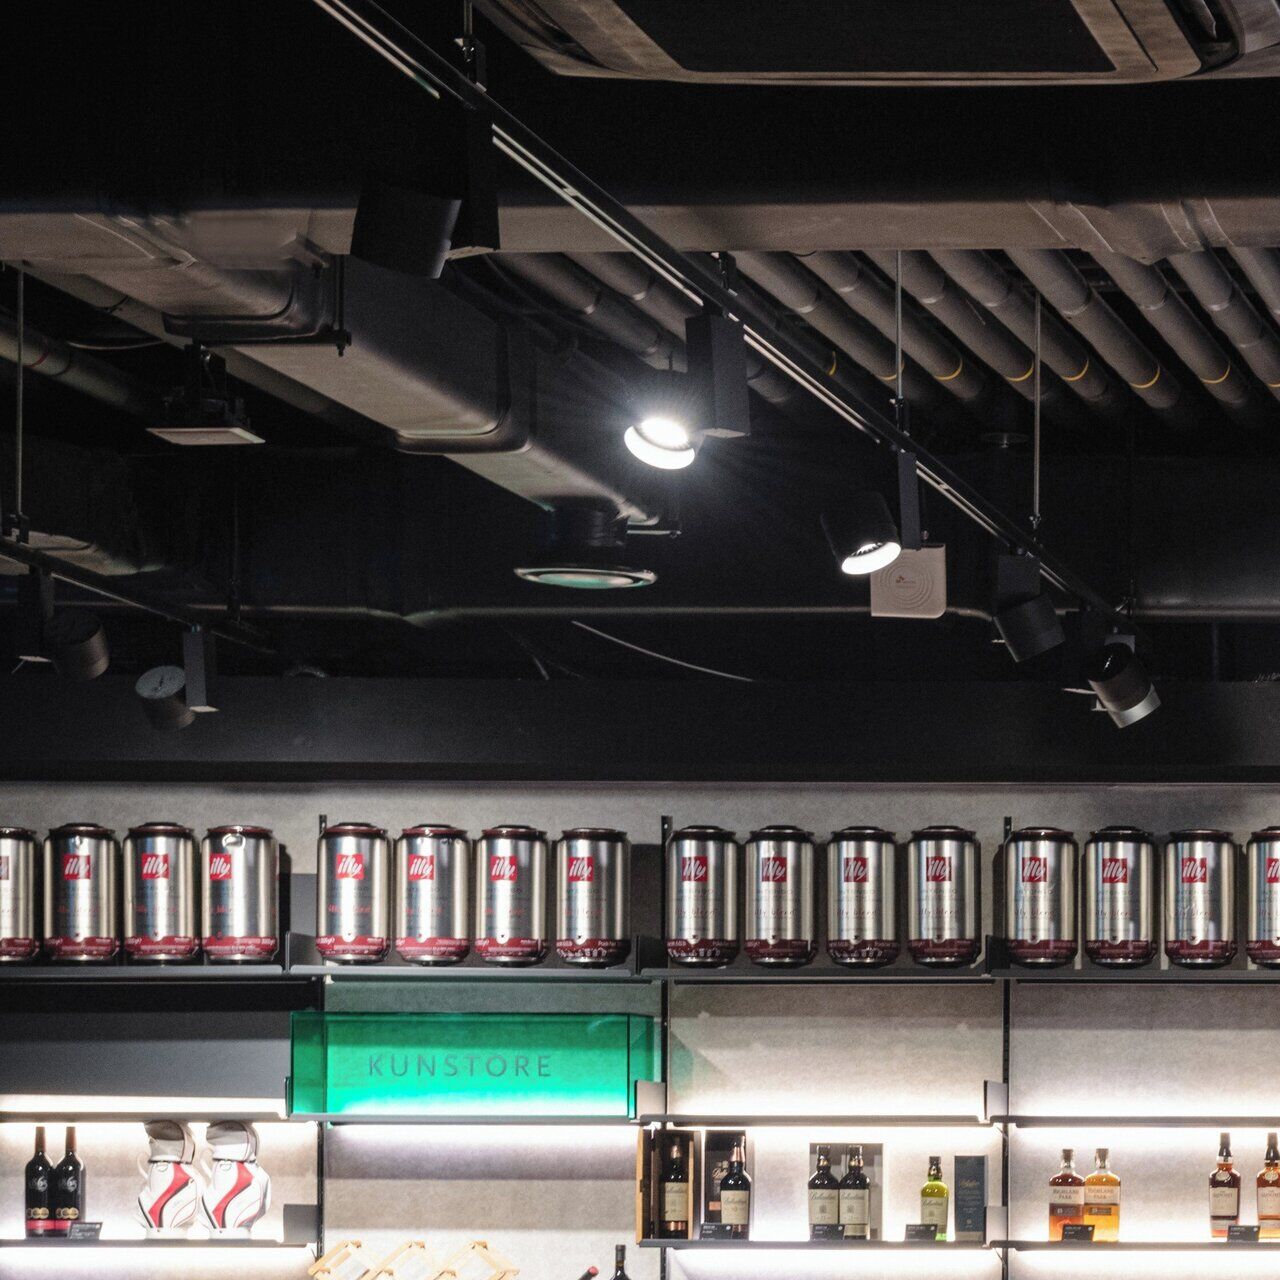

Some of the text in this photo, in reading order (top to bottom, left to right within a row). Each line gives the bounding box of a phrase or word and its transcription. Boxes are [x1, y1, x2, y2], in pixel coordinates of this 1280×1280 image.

[65, 856, 90, 879] illy
[143, 855, 168, 879] illy
[209, 856, 230, 879] illy
[336, 856, 362, 879] illy
[409, 857, 433, 880] illy
[491, 857, 516, 880] illy
[570, 858, 592, 880] illy
[683, 858, 707, 880] illy
[763, 858, 786, 880] illy
[845, 859, 868, 880] illy
[926, 858, 950, 880] illy
[1022, 860, 1046, 882] illy
[1102, 861, 1126, 882] illy
[1182, 860, 1205, 882] illy
[369, 1055, 551, 1077] KUNSTORE
